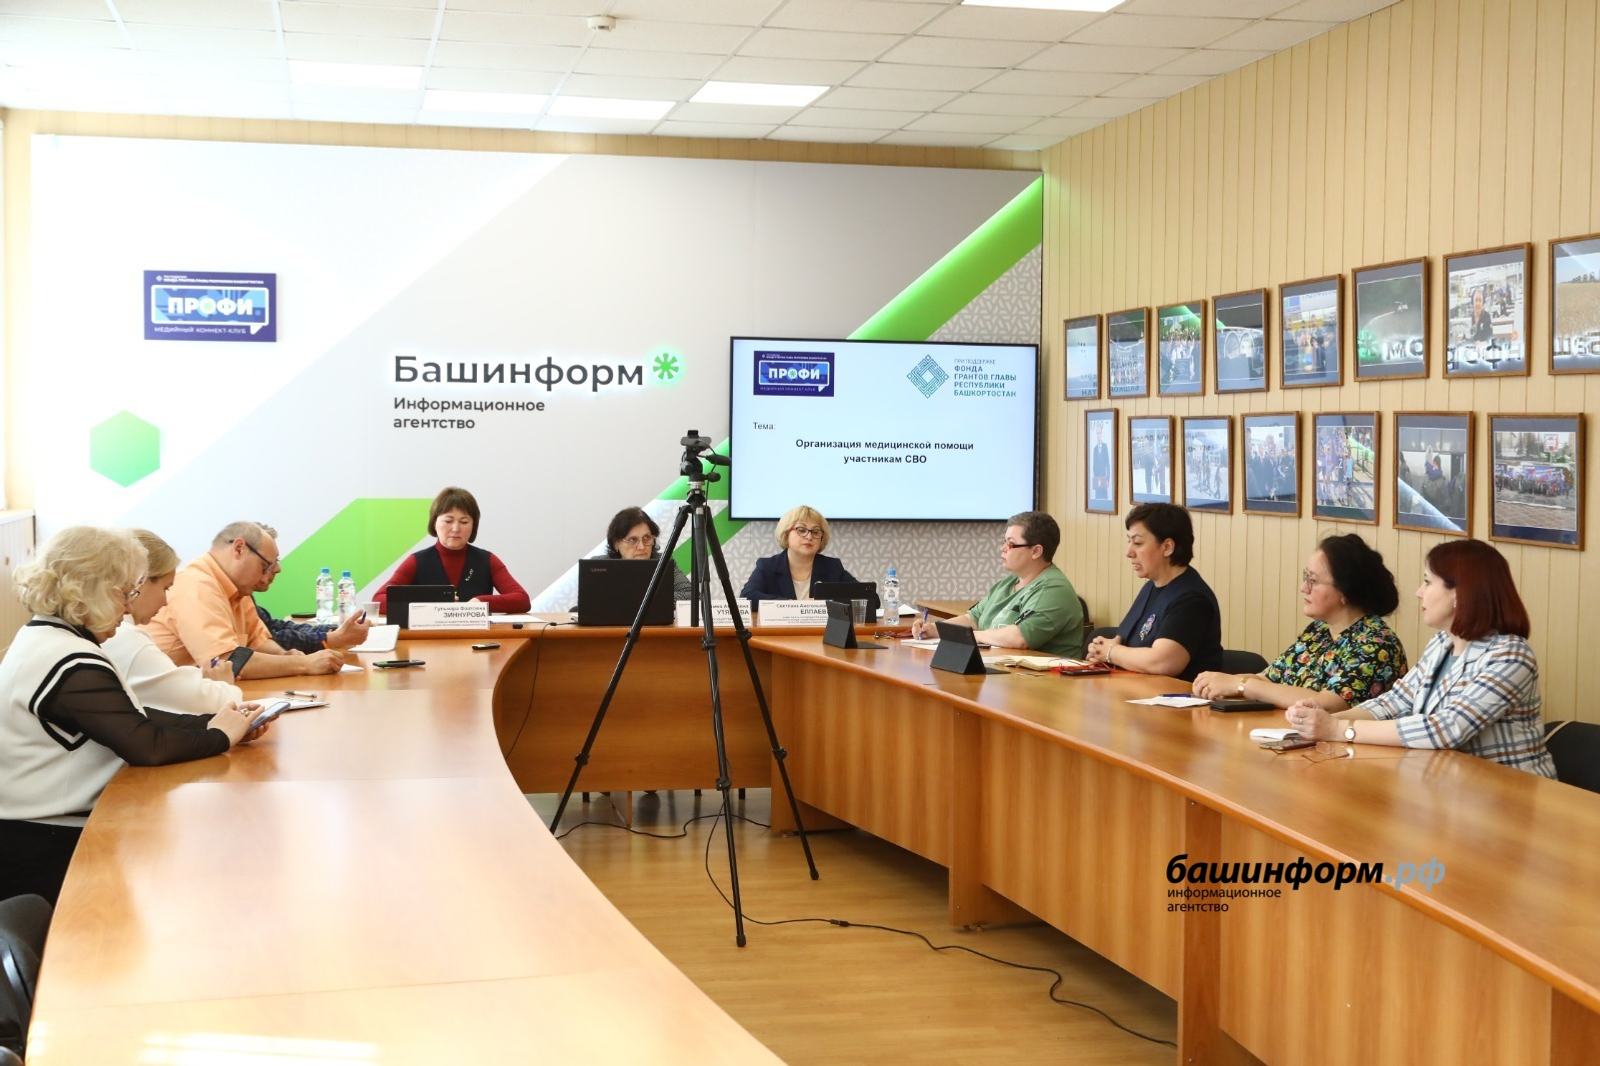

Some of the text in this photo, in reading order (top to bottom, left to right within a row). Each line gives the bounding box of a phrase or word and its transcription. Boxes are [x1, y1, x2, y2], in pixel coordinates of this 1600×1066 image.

[167, 296, 253, 316] ПРОФИ
[394, 355, 643, 392] Башинформ
[769, 368, 820, 380] ПРОФИ
[954, 381, 1005, 389] РЕСПУБЛИКИ
[954, 389, 1017, 397] БАШКОРТОСТАН
[393, 397, 545, 413] Информационное
[393, 418, 475, 430] агентство
[753, 422, 776, 430] Тема:
[795, 439, 974, 451] Организация медицинской помощи
[843, 454, 927, 464] участникам СВО
